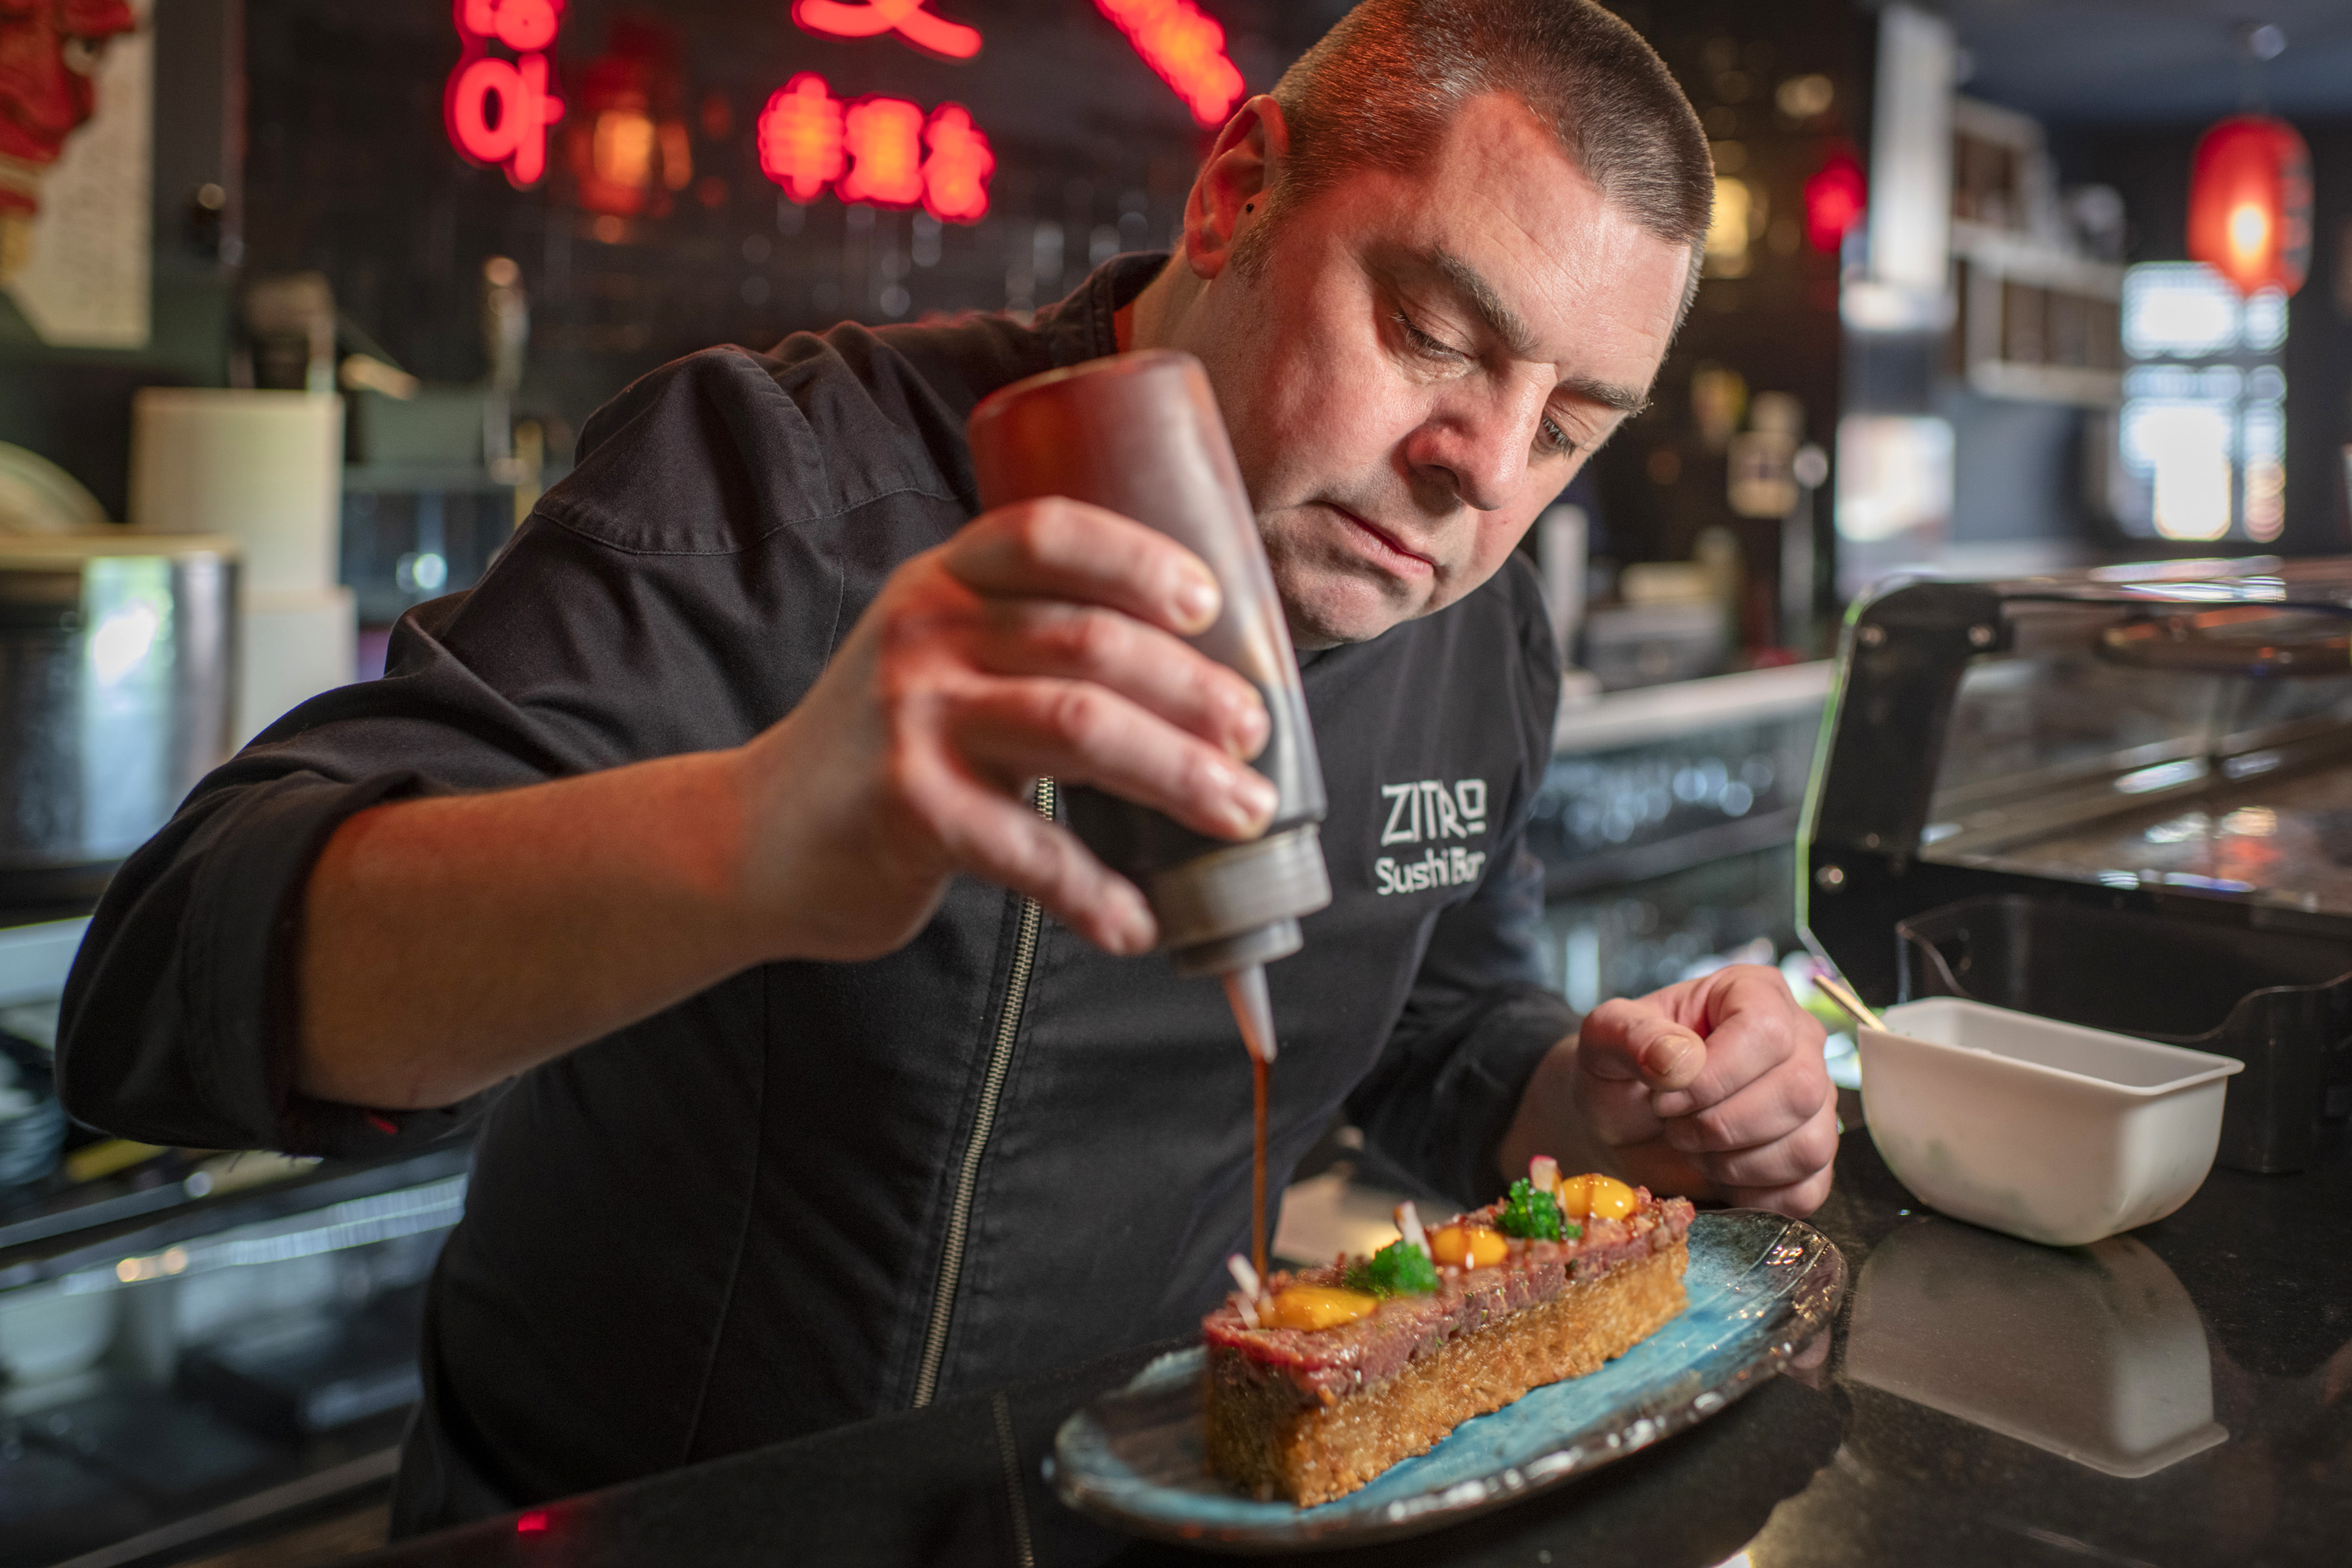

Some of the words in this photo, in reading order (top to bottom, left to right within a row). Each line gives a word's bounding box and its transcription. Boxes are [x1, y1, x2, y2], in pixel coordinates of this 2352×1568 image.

[1380, 779, 1486, 846] ZITRO
[1375, 848, 1449, 896] Sushi
[1450, 847, 1485, 884] Bar
